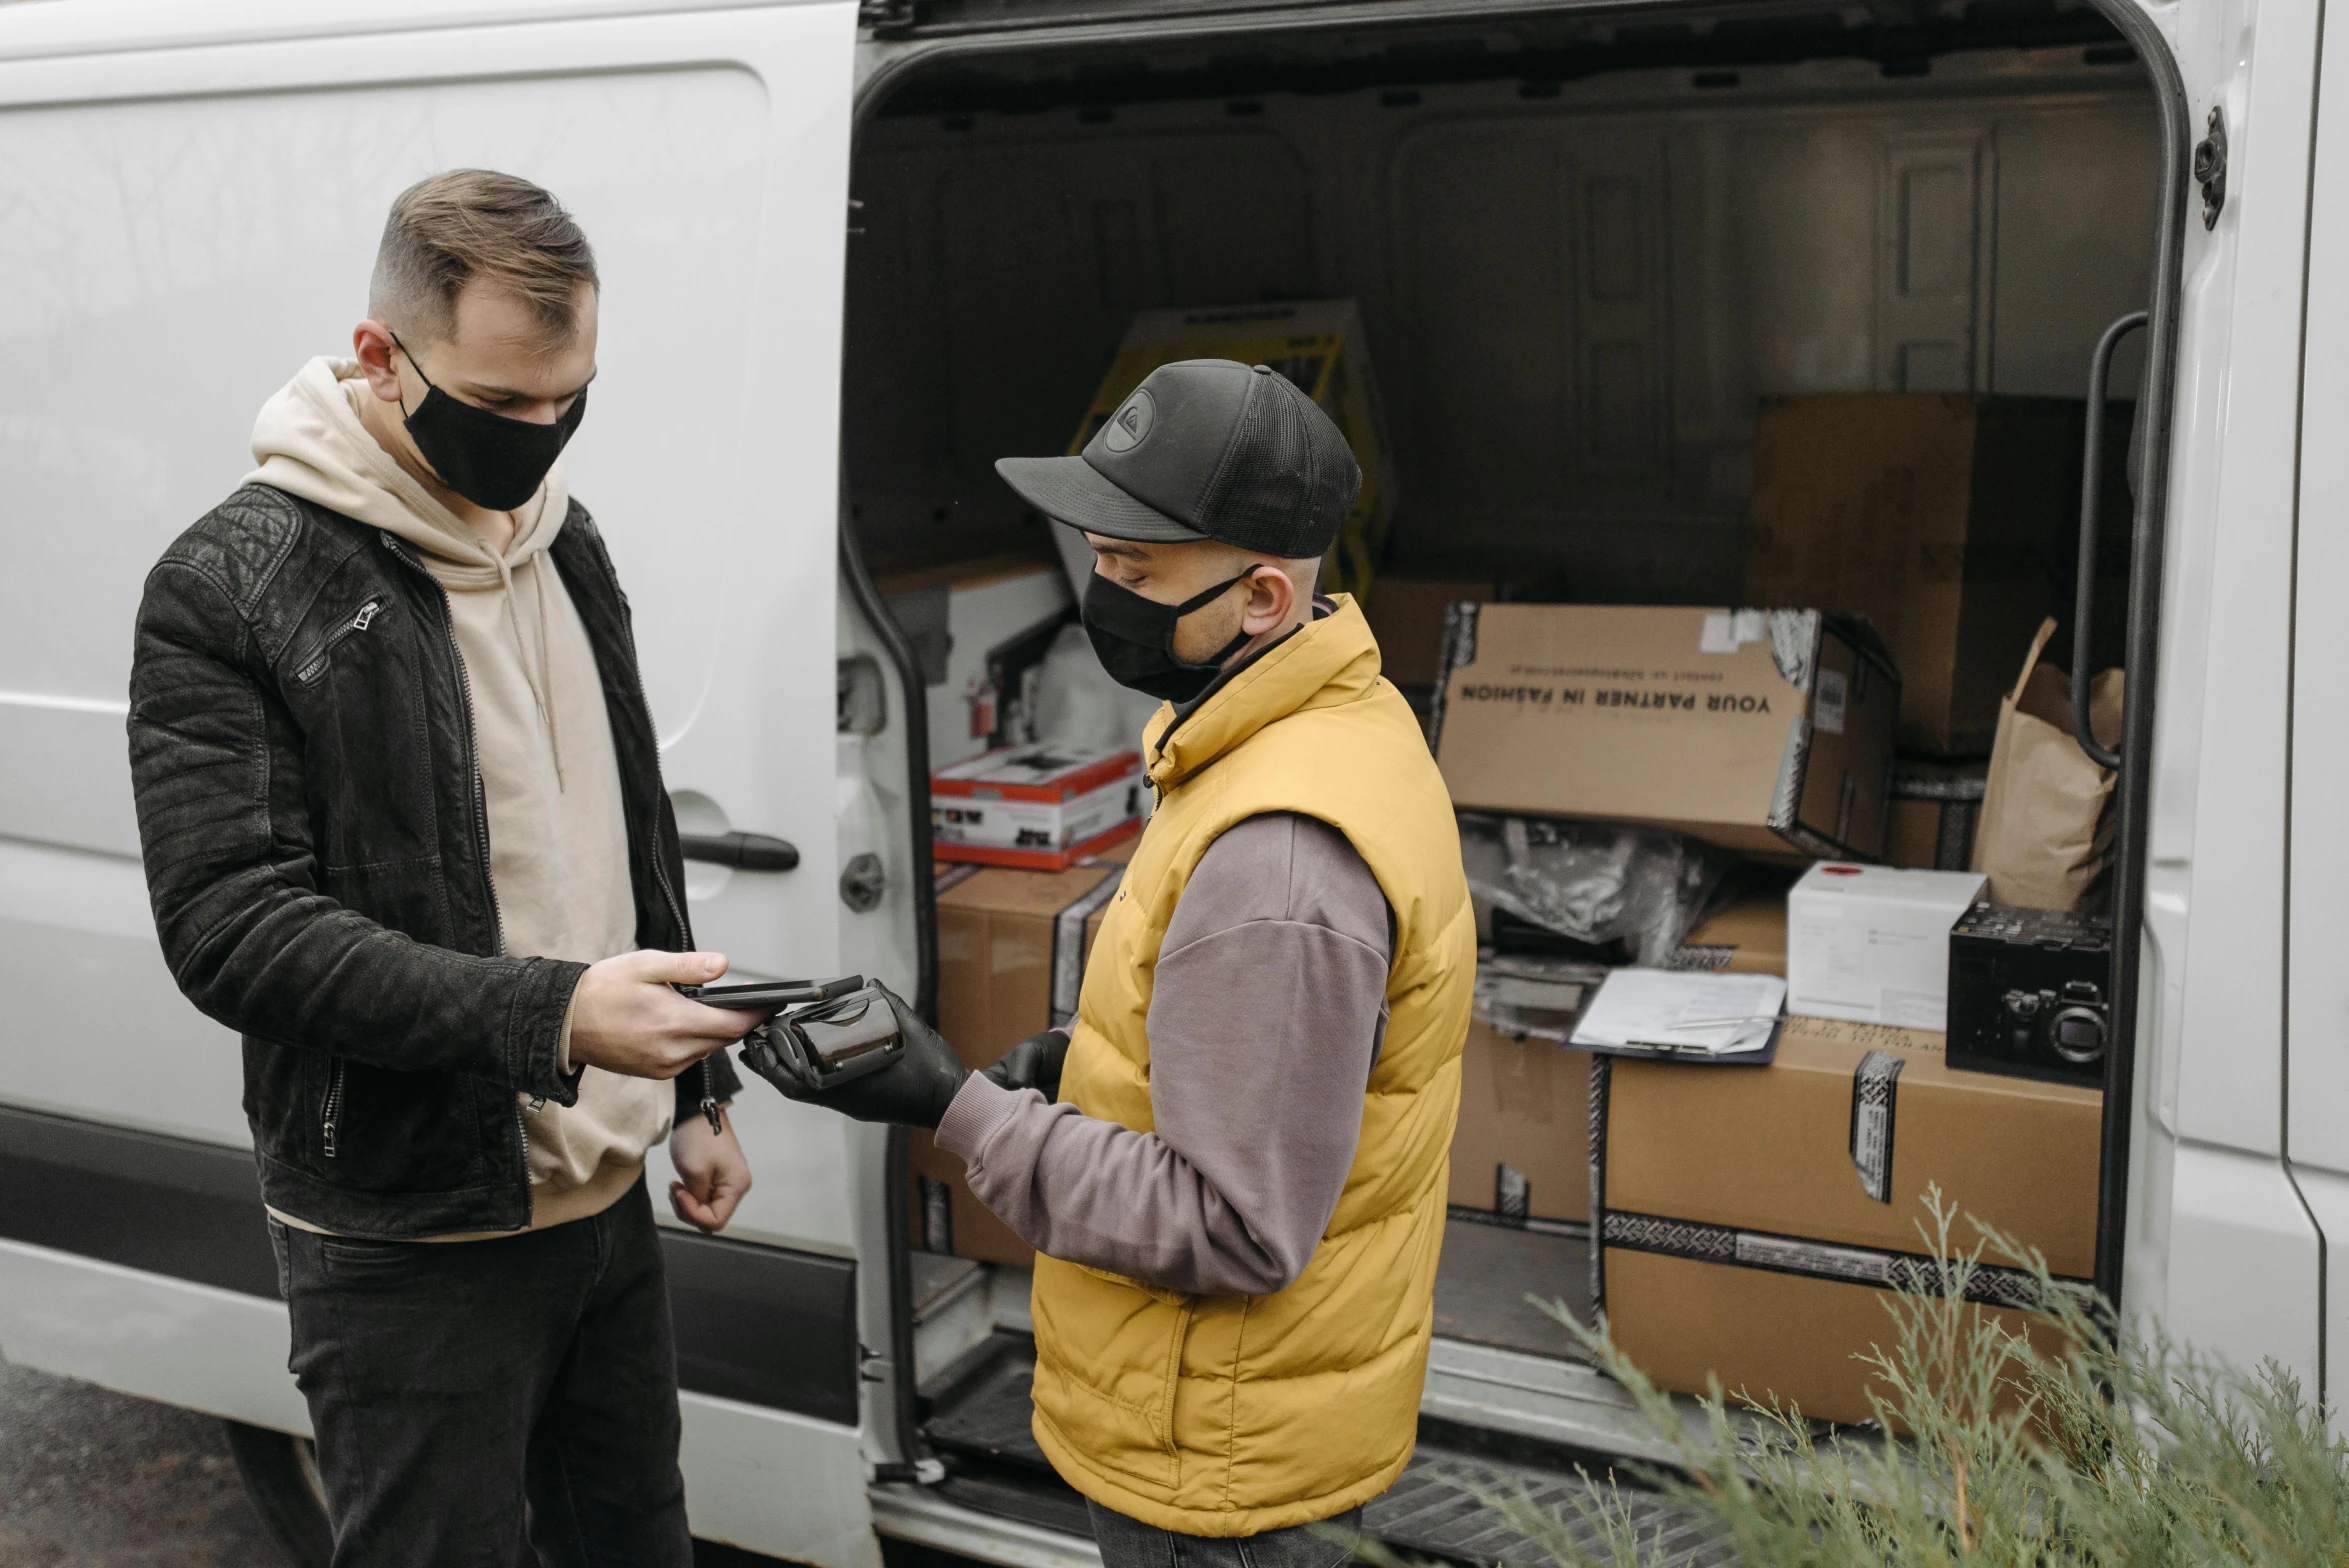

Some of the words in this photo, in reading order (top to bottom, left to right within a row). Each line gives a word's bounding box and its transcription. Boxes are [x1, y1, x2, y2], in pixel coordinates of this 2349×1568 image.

[1461, 685, 1553, 704] FASHION
[1562, 688, 1586, 704] IN
[1595, 689, 1696, 710] PARTNER
[1707, 694, 1771, 713] YOUR
